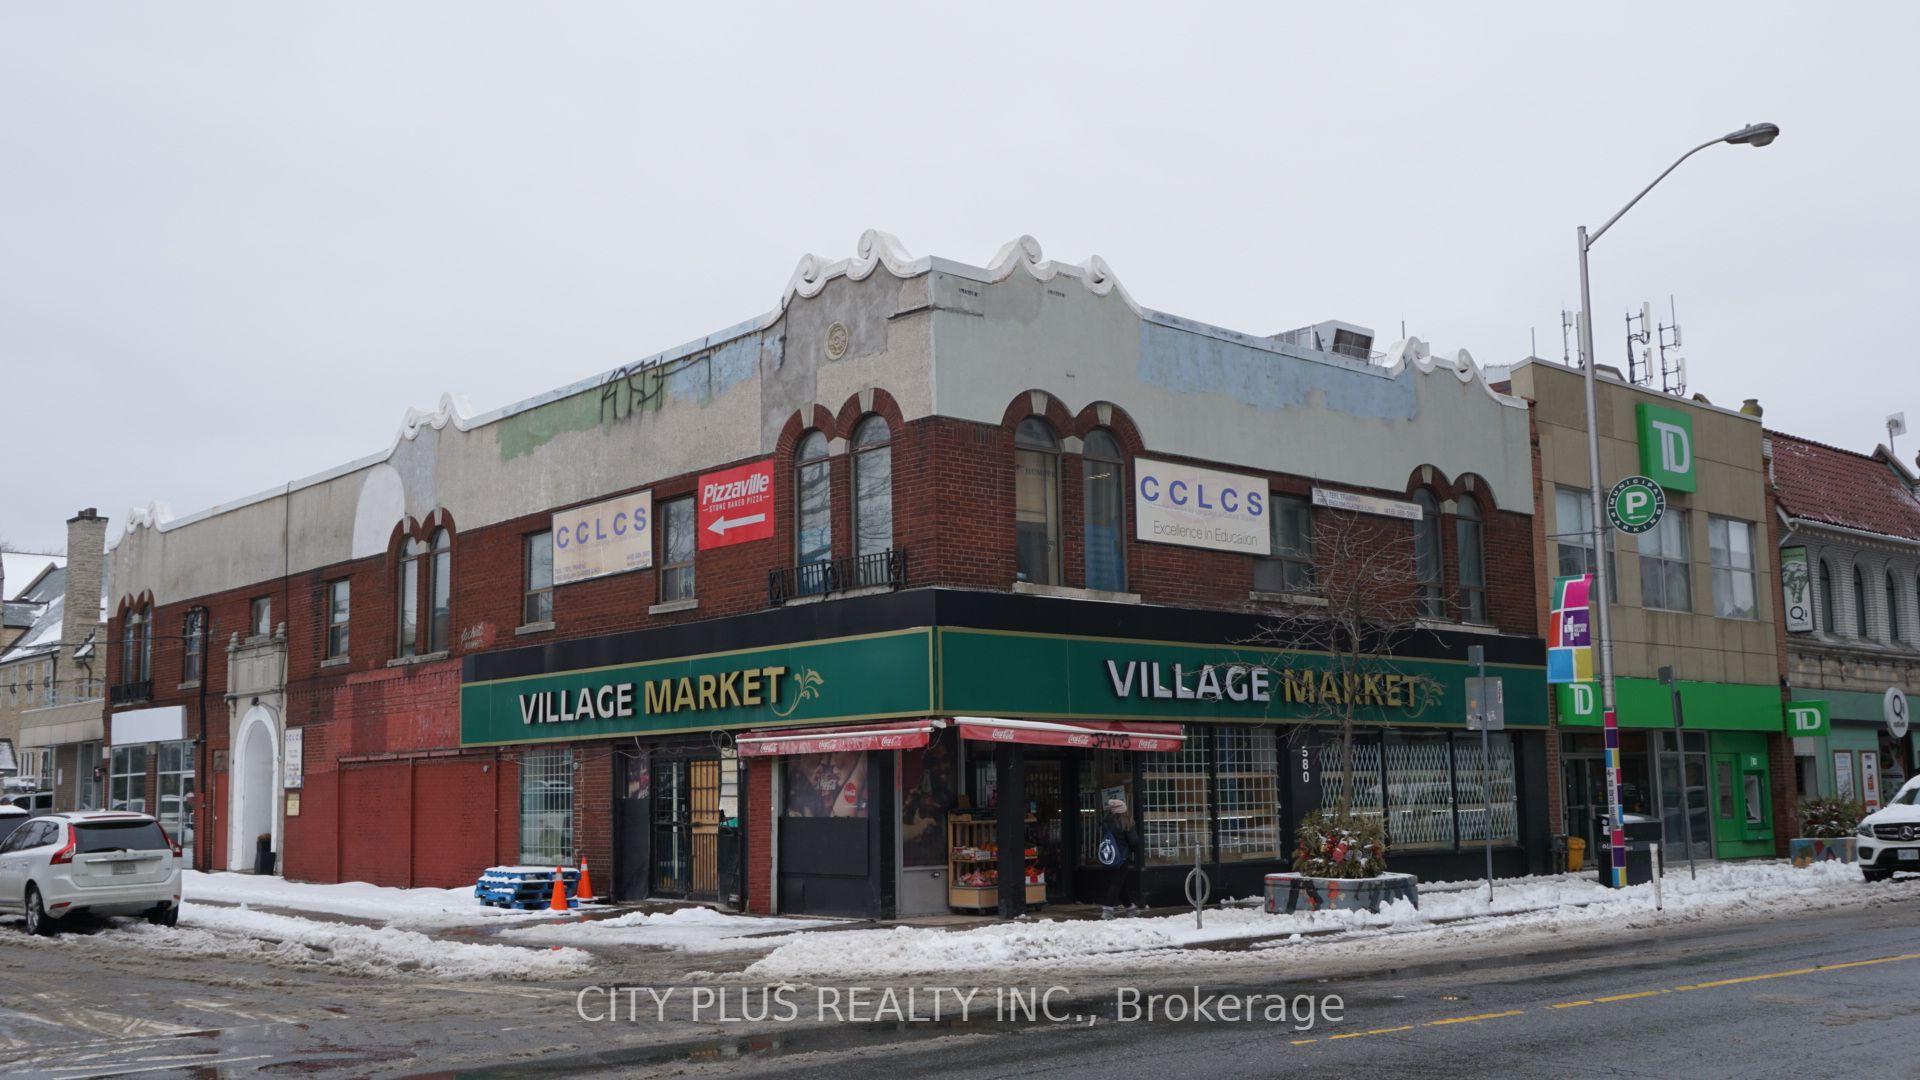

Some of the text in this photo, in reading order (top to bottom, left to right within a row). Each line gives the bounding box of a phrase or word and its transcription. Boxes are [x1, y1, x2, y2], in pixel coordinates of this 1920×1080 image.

[1652, 420, 1690, 474] TD
[703, 473, 770, 505] Pizzaville
[709, 495, 763, 512] STONE BAKED PIZZA
[1140, 476, 1263, 516] CCLCS
[1609, 478, 1661, 505] MUNICIPAL
[1626, 491, 1648, 515] P
[556, 507, 647, 549] CCLCS
[1153, 520, 1258, 546] Excellence in Education
[1610, 508, 1661, 533] PARKING
[519, 666, 786, 725] VILLAGE MARKET
[1106, 660, 1419, 707] VILLAGE MARKET
[1569, 683, 1594, 715] TD
[1789, 707, 1822, 731] TD
[1302, 746, 1310, 783] 580
